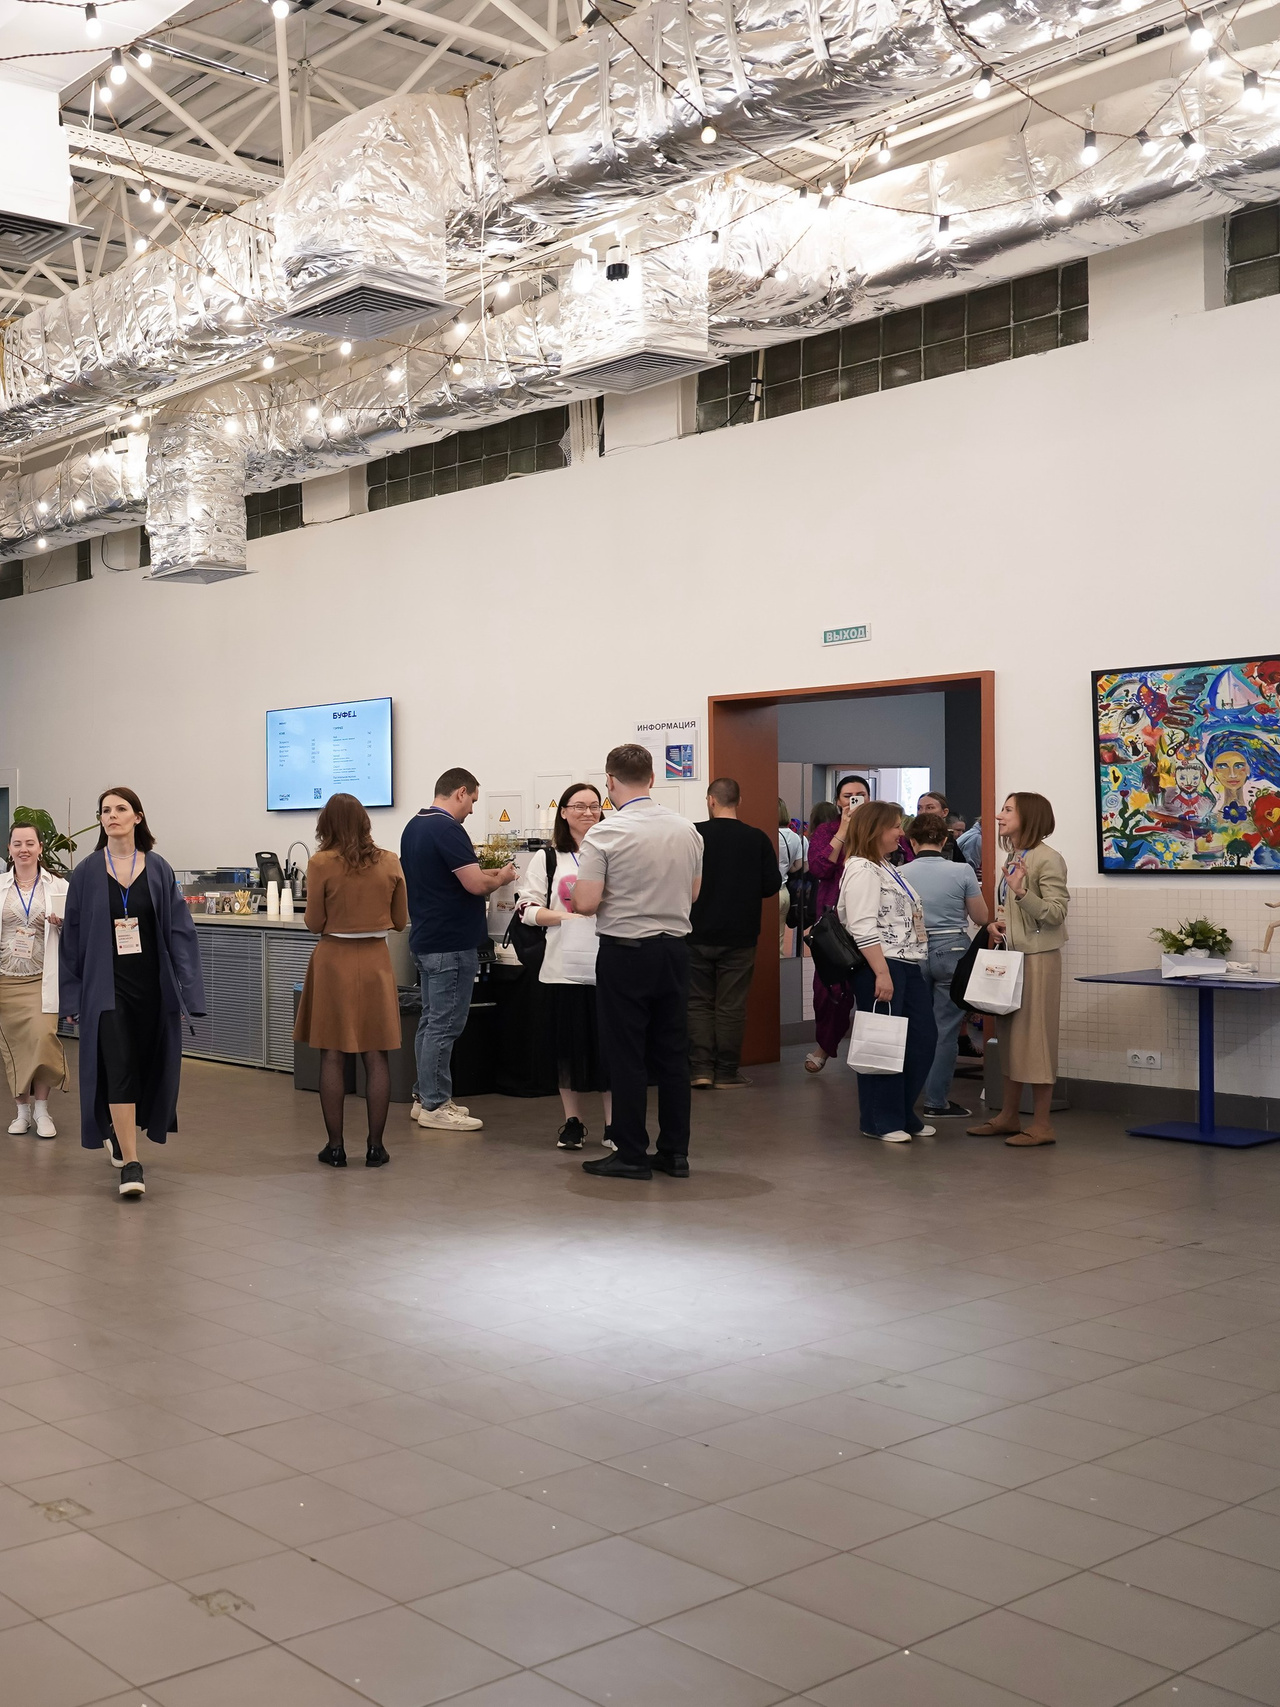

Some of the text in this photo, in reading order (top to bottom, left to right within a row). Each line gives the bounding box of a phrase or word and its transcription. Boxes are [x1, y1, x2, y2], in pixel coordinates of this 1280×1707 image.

[825, 627, 866, 642] ВЫХОД
[332, 710, 357, 719] БУФЕТ
[637, 720, 696, 732] ИНФОРМАЦИЯ
